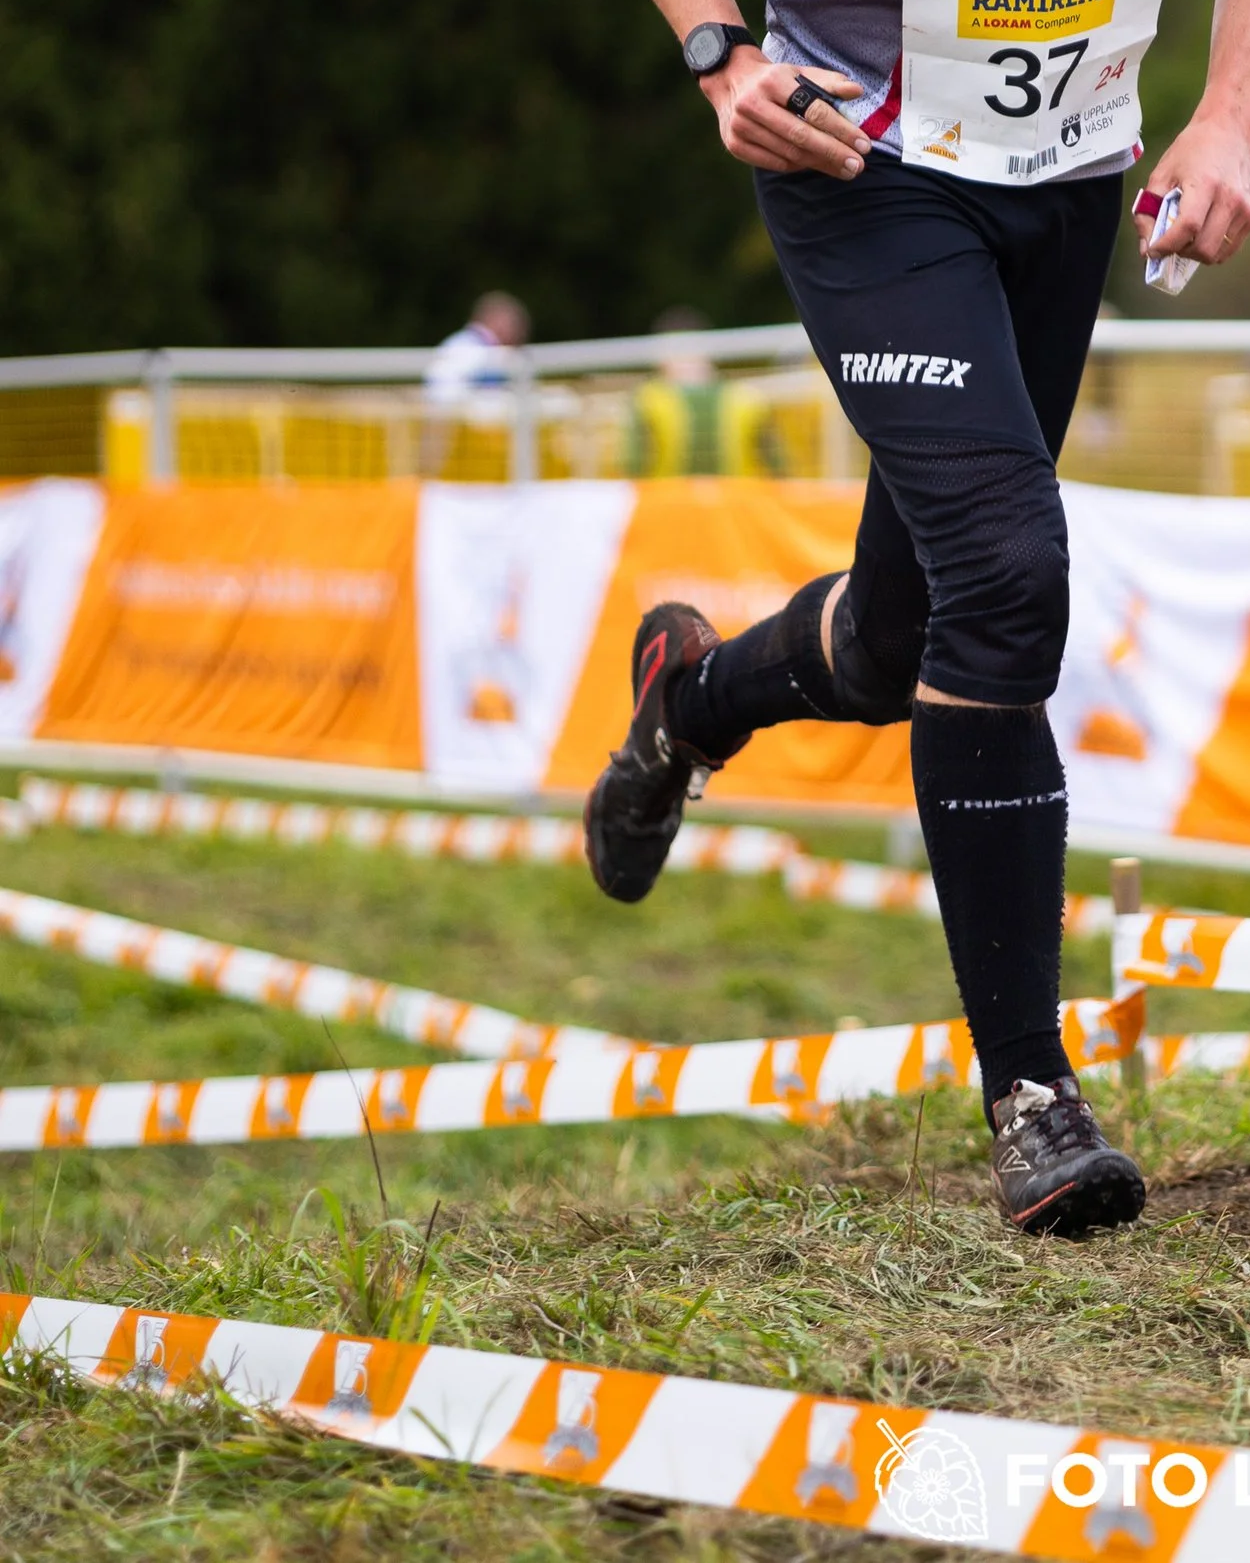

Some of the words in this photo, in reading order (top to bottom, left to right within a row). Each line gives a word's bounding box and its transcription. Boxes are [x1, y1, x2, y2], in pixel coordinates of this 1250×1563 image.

[972, 18, 980, 27] A
[984, 18, 1031, 29] LOXAM
[1035, 13, 1080, 30] Company
[984, 38, 1089, 118] 37
[1094, 57, 1127, 91] 24
[1083, 93, 1131, 121] UPPLANDS
[840, 353, 972, 388] TRIMTEX
